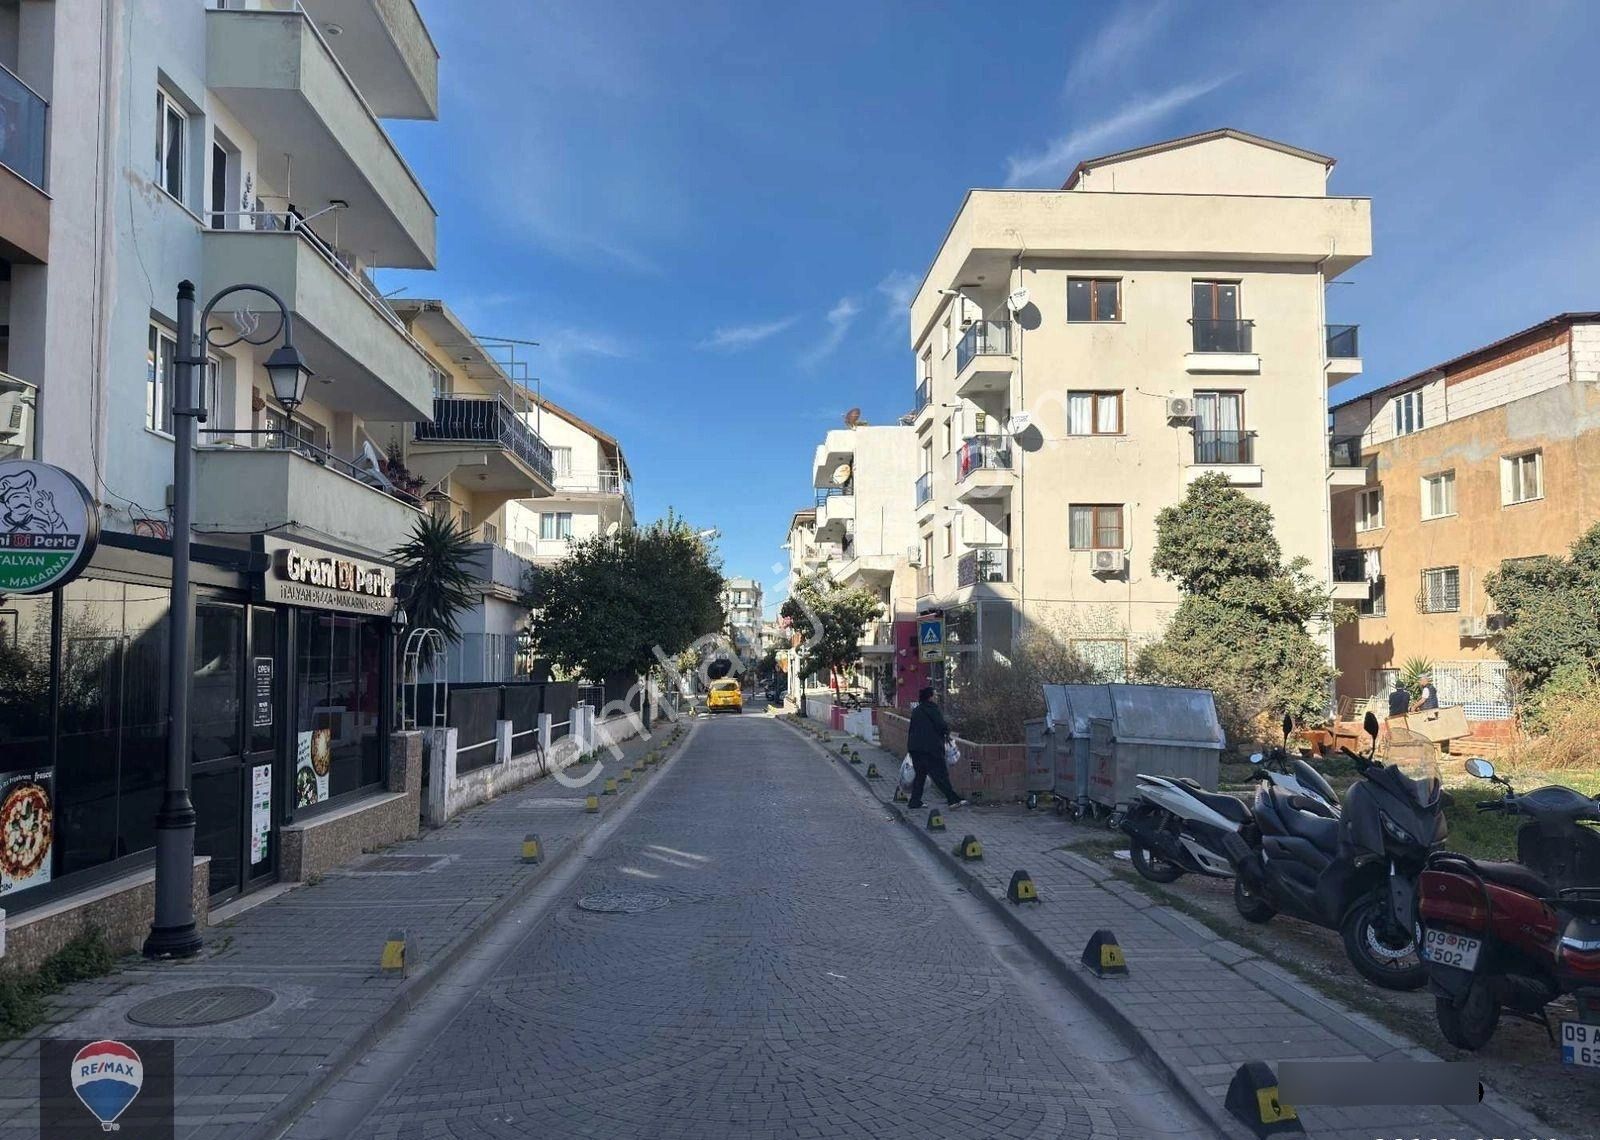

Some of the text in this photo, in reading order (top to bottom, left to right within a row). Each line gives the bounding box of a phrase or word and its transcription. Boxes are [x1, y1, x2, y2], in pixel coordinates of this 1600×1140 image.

[34, 535, 76, 547] Perle
[9, 556, 69, 587] MAKARNA
[356, 564, 392, 598] Perle
[1427, 931, 1477, 952] 09 RP
[1434, 947, 1463, 966] 502
[1565, 1025, 1586, 1043] 09
